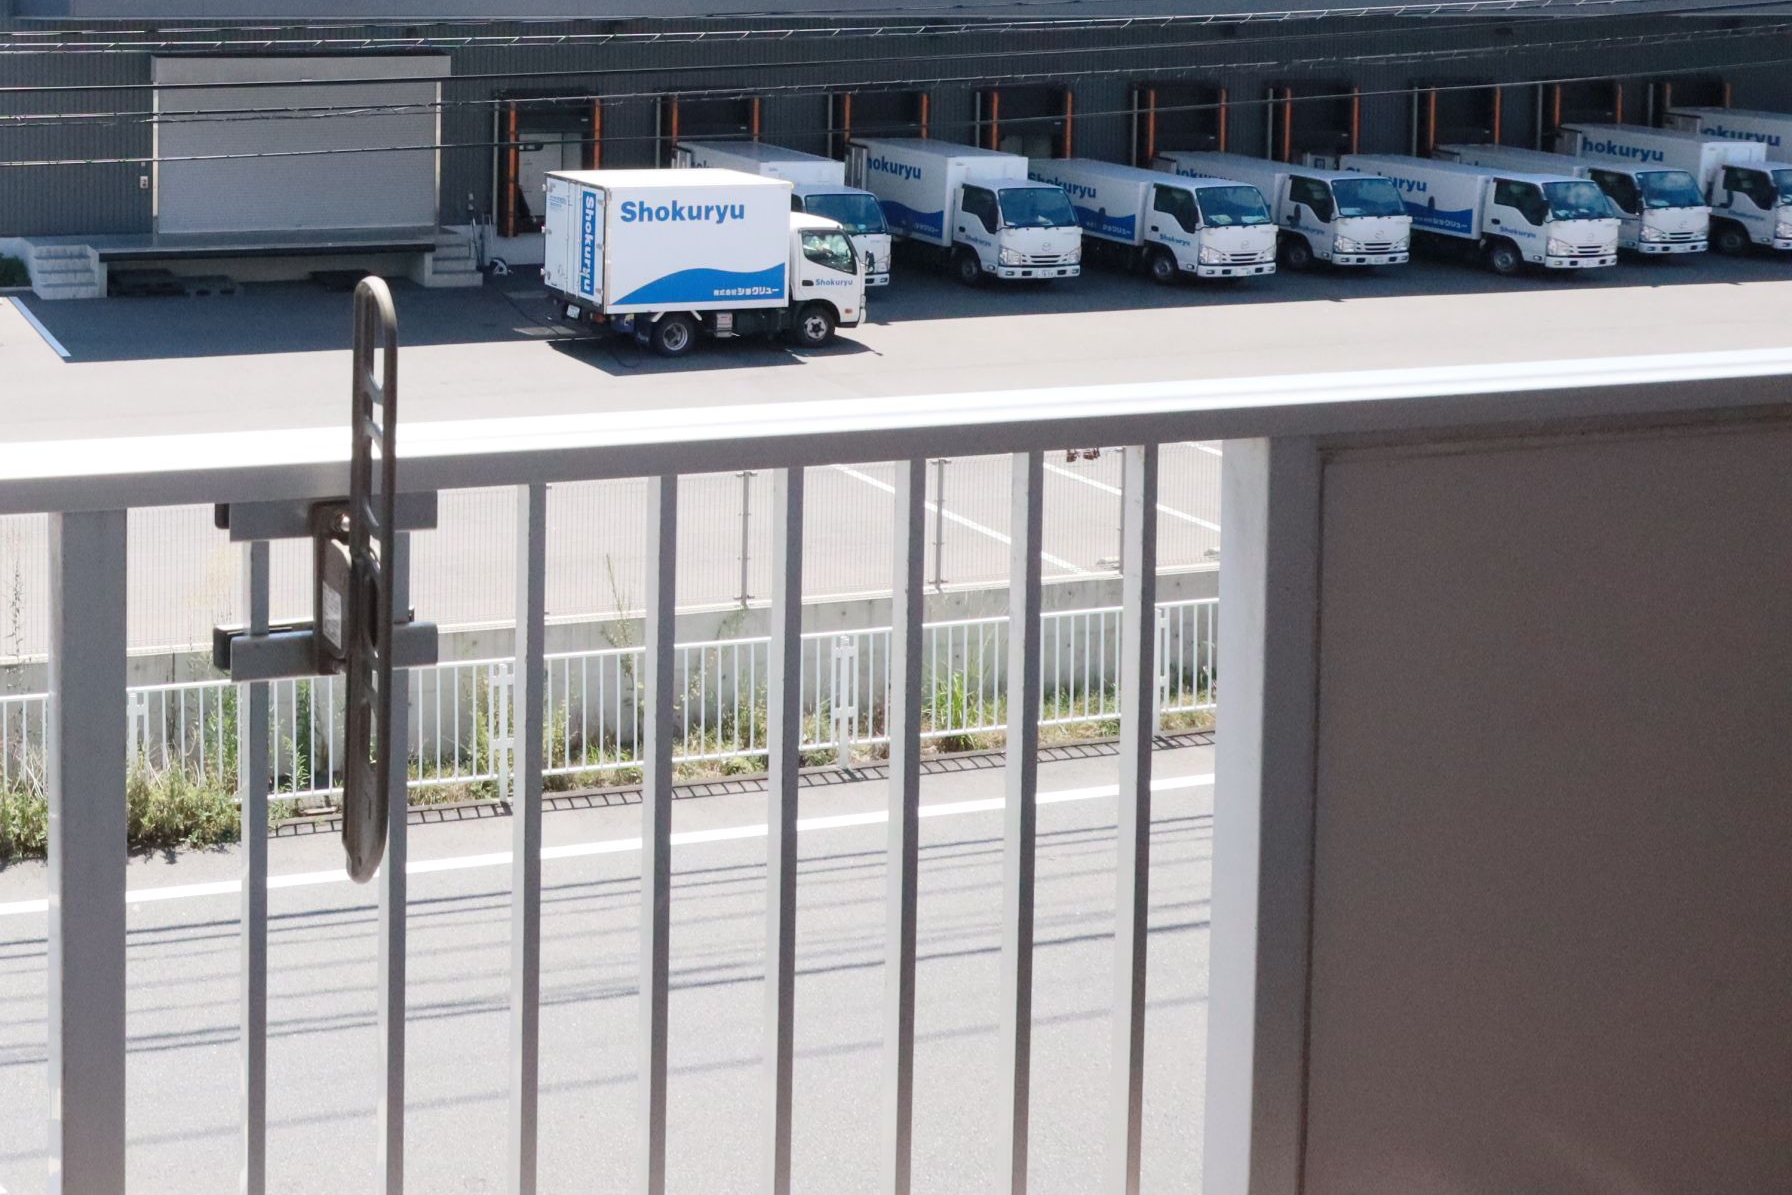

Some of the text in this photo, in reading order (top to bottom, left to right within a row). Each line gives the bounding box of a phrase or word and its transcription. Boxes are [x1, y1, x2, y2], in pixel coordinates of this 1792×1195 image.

[620, 200, 745, 224] Shokuryu
[581, 196, 595, 291] Shokuryu
[815, 278, 853, 287] Shokuryu
